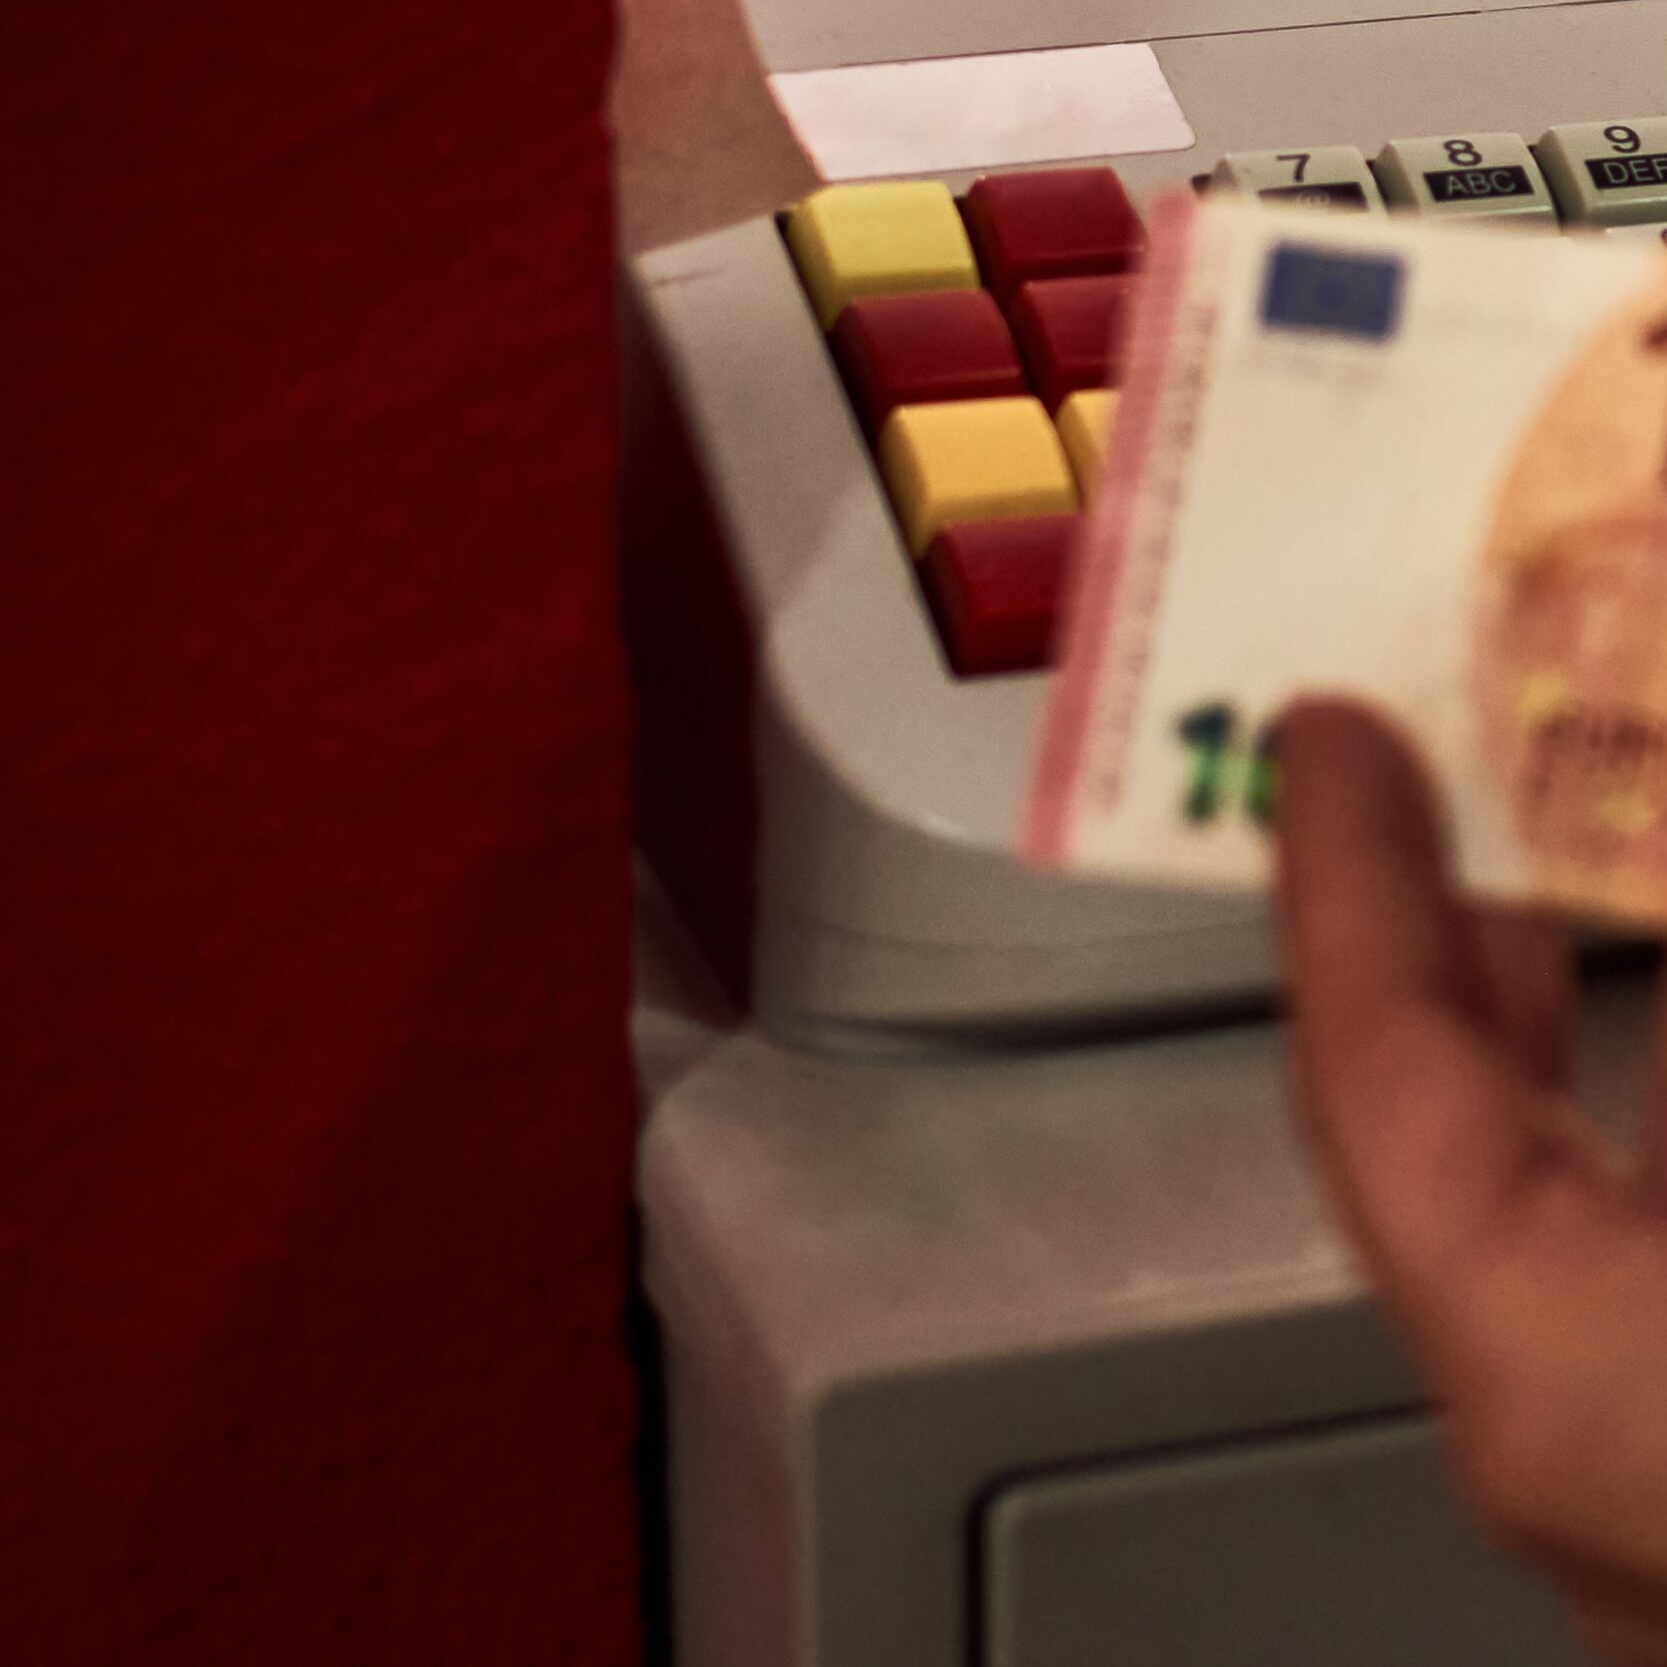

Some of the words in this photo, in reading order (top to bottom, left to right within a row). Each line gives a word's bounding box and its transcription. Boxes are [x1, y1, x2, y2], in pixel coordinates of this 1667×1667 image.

[1443, 139, 1482, 167] 8
[1604, 126, 1641, 153] 9
[1276, 154, 1310, 182] 7
[1446, 170, 1516, 196] ABC
